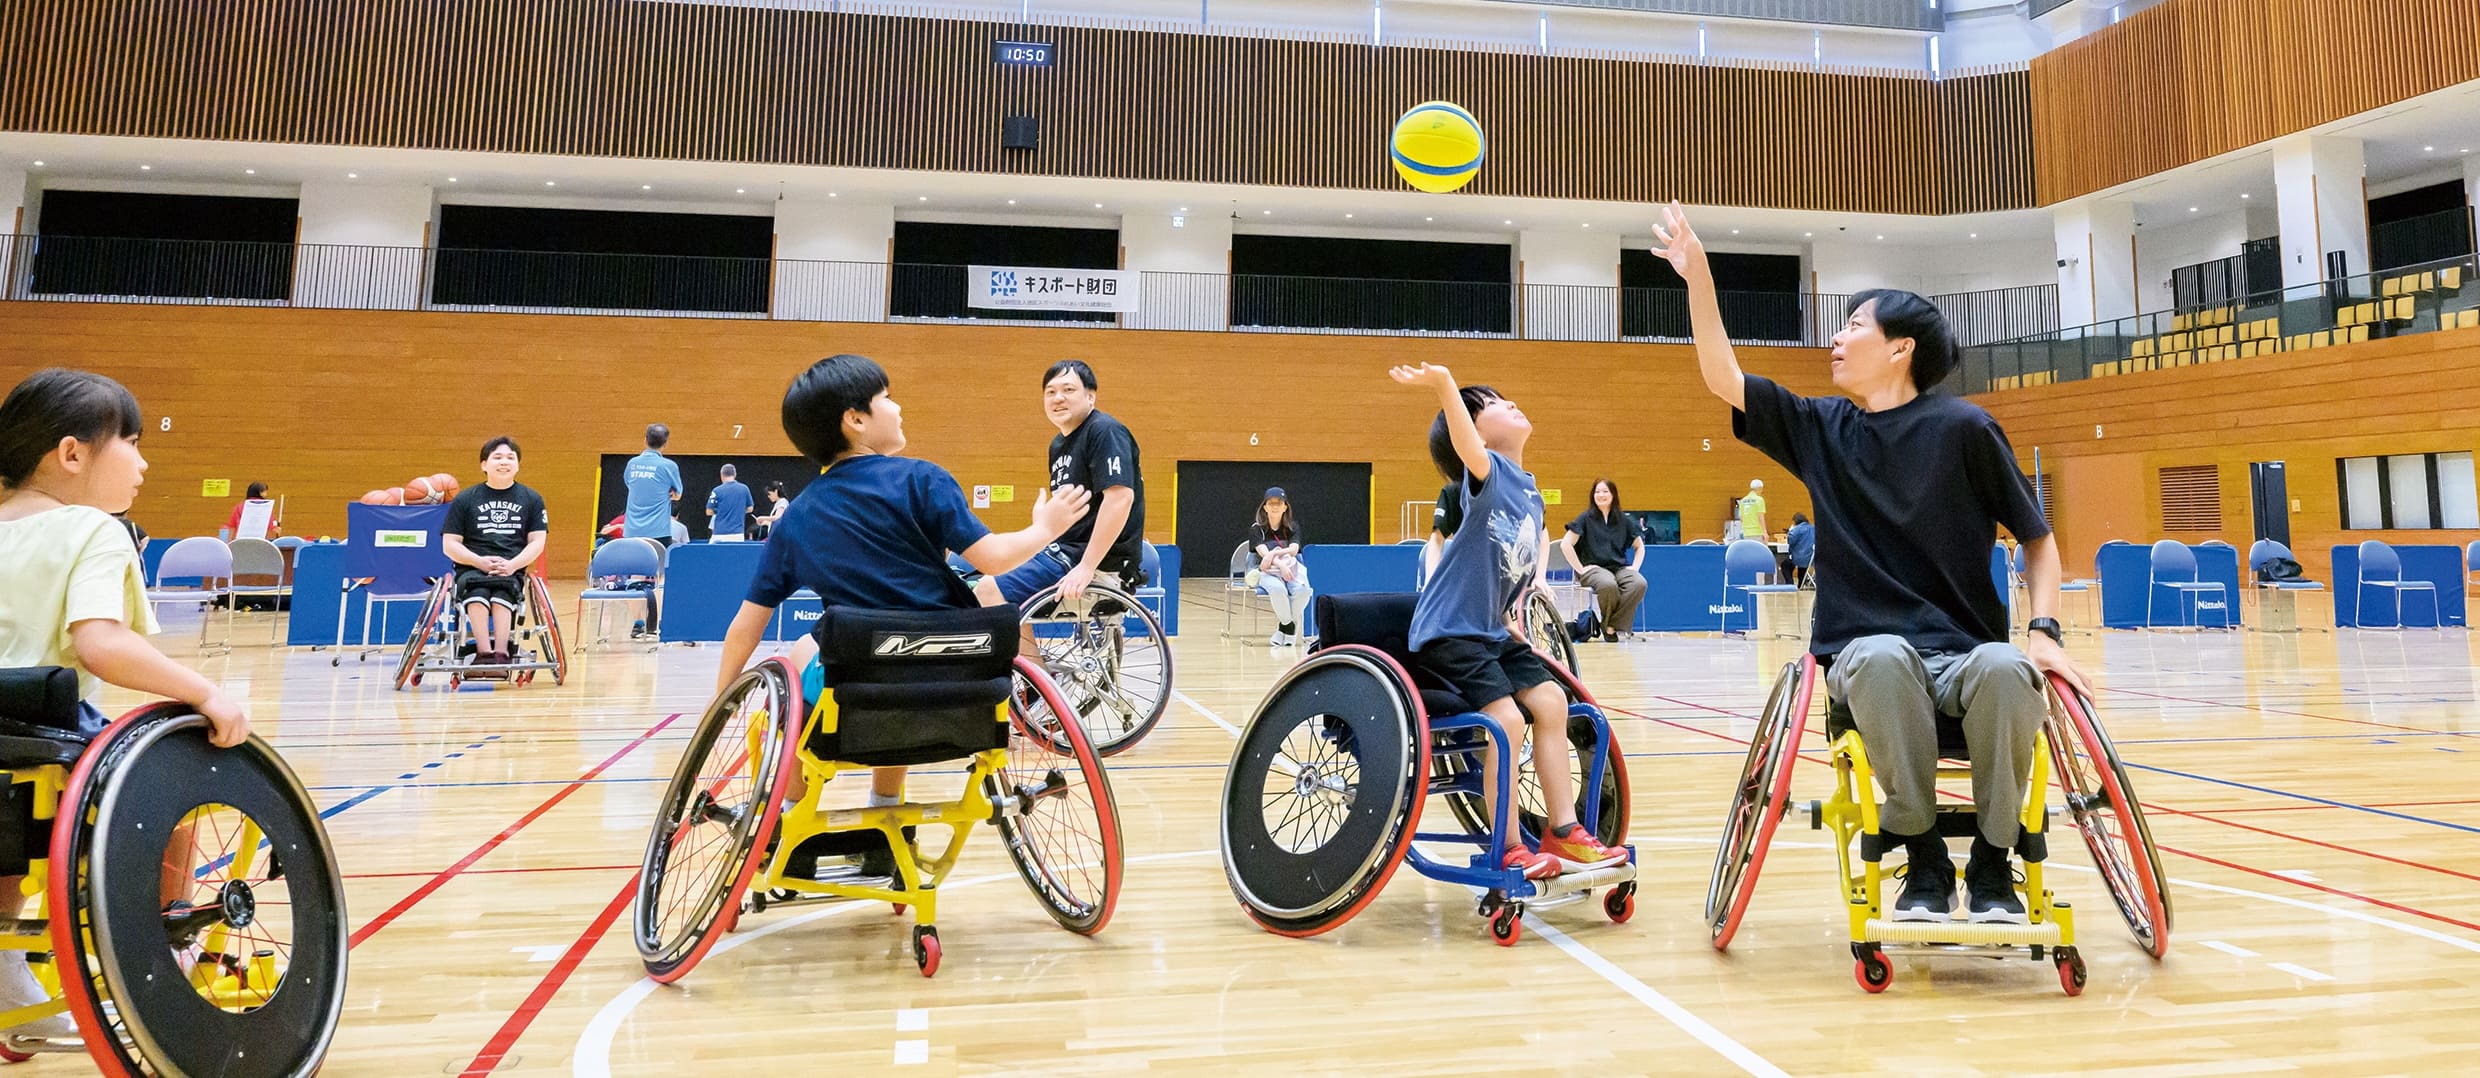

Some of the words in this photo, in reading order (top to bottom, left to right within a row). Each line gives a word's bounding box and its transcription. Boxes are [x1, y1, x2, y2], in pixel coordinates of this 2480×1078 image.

[1007, 48, 1045, 62] 10:50
[1025, 276, 1117, 296] キスポート財団
[160, 416, 171, 431] 8
[732, 424, 743, 439] 7
[2096, 424, 2103, 439] B
[1250, 432, 1259, 446] 6
[1702, 438, 1711, 451] 5
[1107, 455, 1121, 476] 14
[630, 470, 656, 479] STAFF
[477, 501, 522, 513] KAWASAKI
